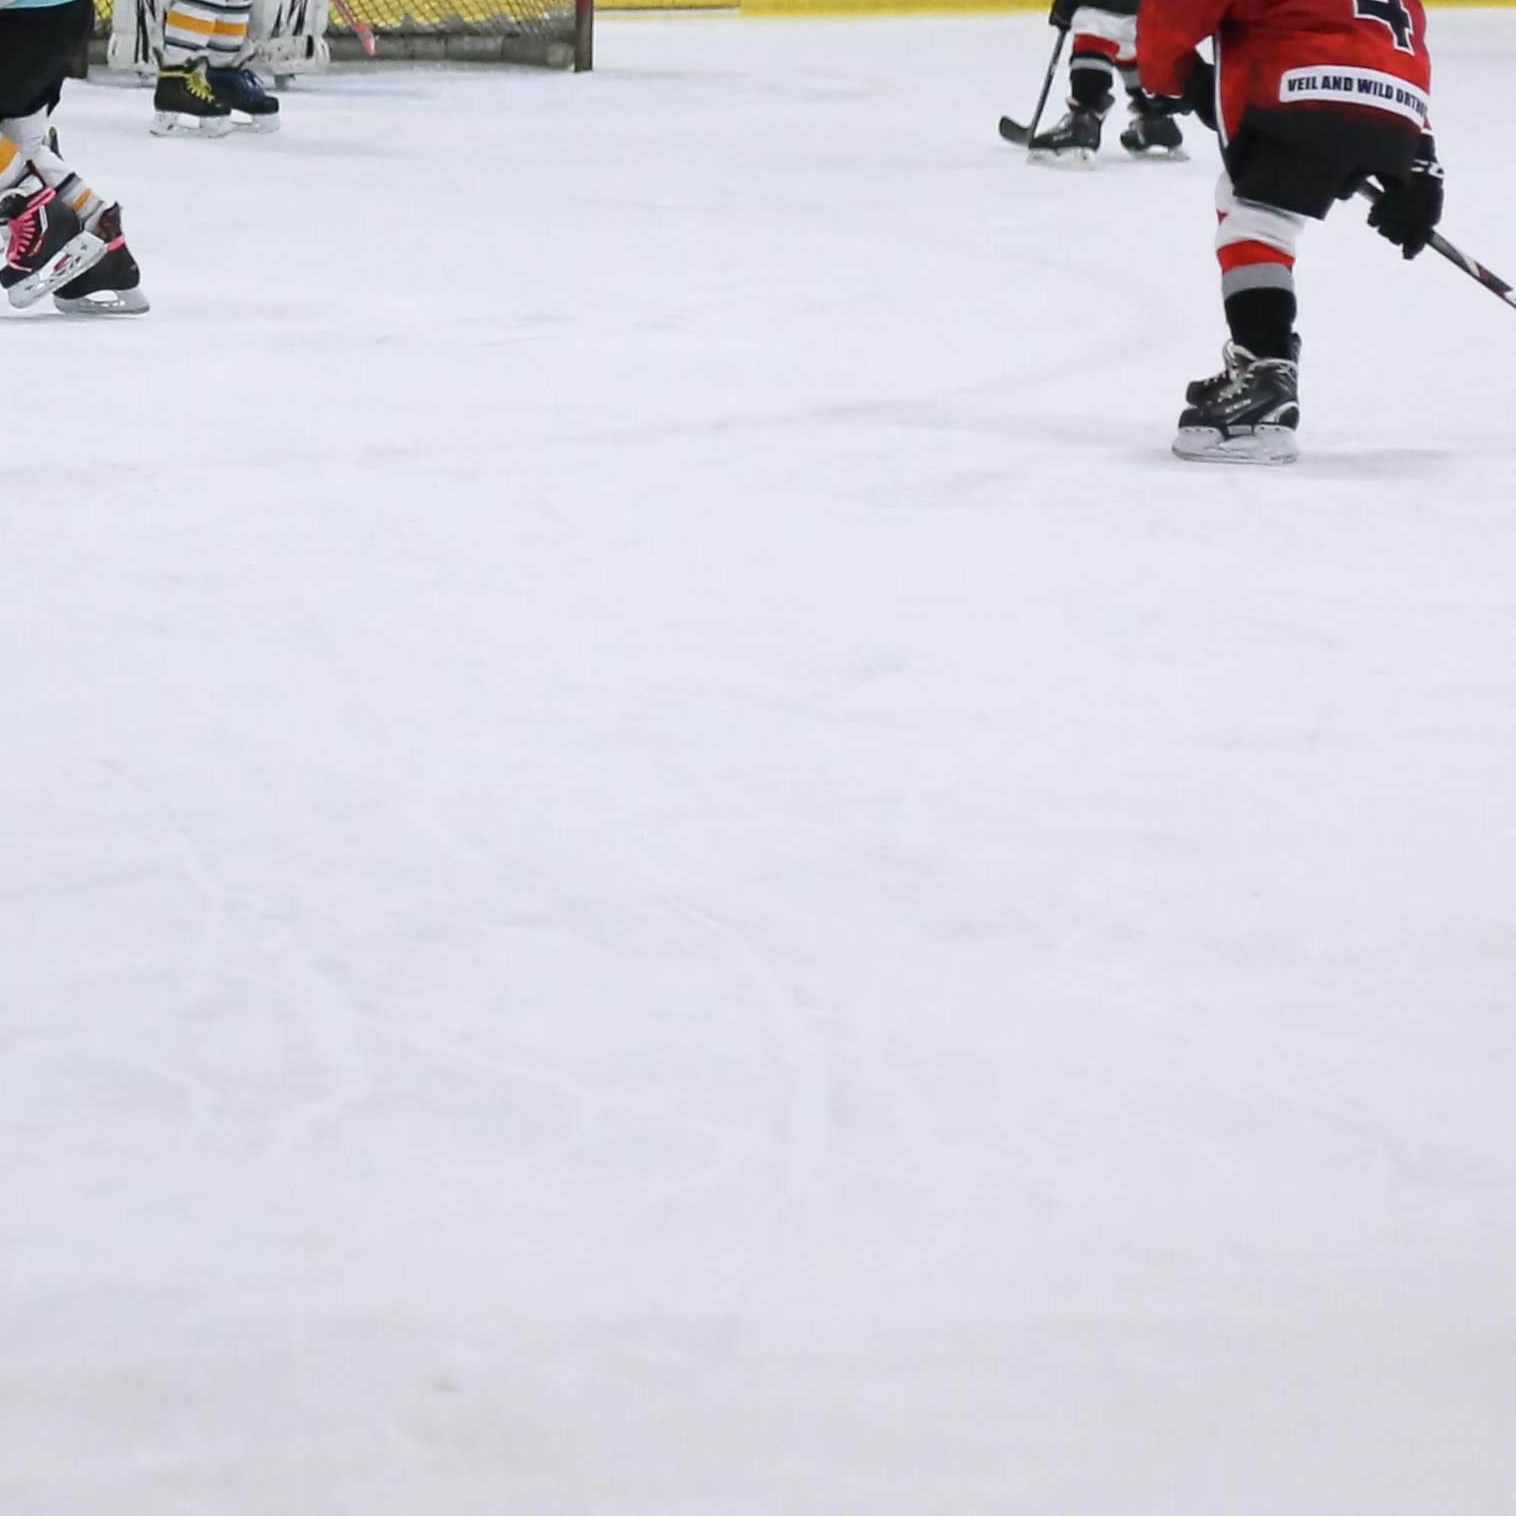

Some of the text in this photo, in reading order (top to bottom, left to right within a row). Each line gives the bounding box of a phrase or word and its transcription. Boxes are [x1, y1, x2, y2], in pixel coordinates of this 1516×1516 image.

[1287, 76, 1318, 92] VEIL
[1321, 75, 1353, 92] AND
[1357, 78, 1394, 99] WILD
